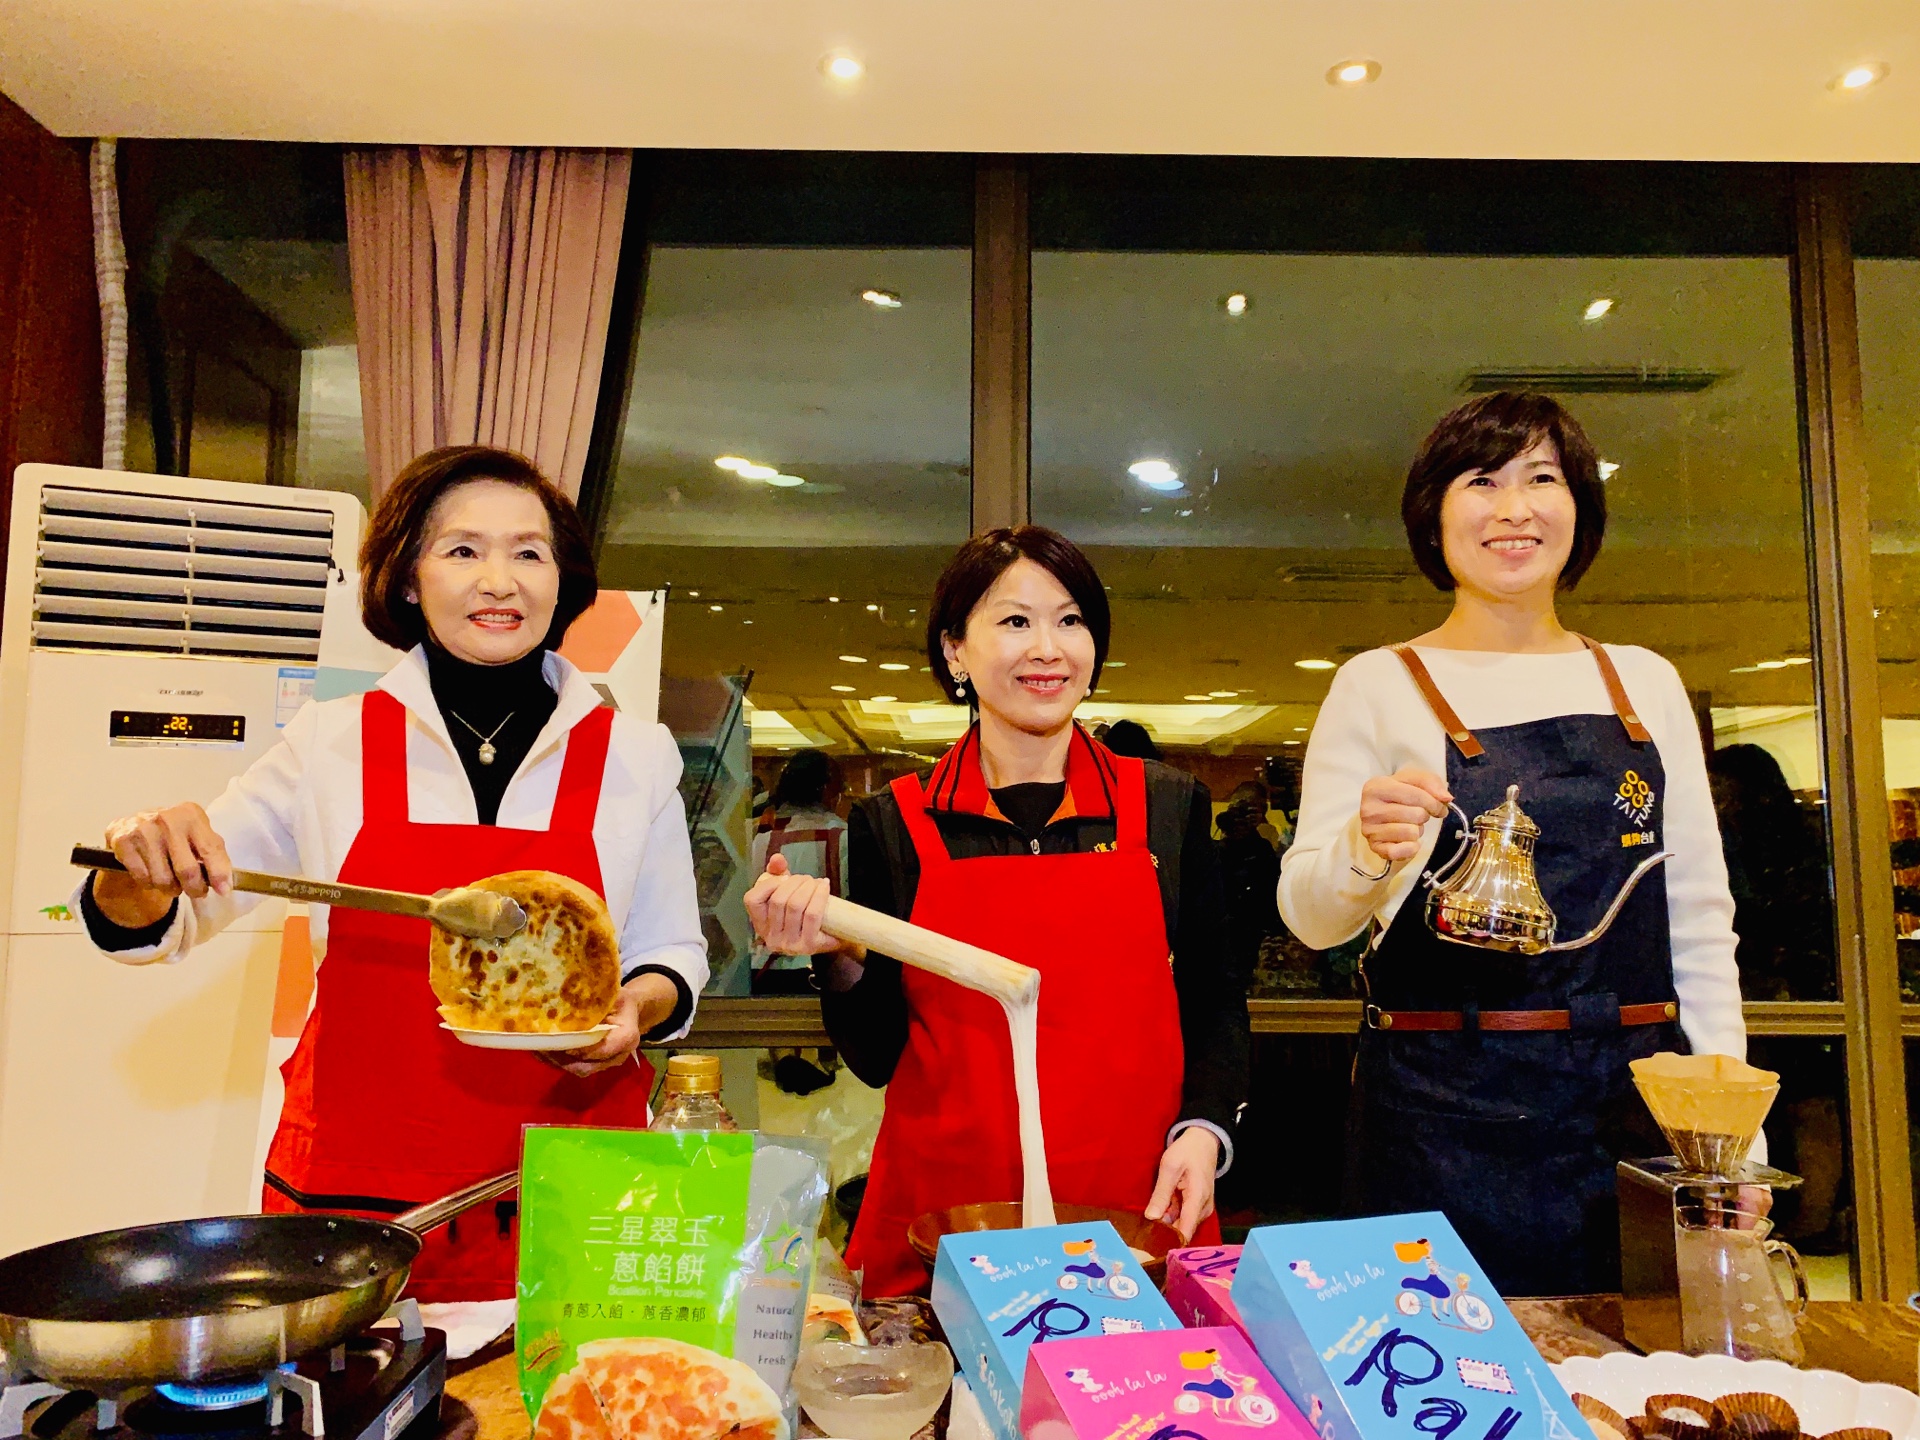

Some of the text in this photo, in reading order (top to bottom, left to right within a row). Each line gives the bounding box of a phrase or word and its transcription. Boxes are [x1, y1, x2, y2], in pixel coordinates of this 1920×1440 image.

[170, 716, 188, 730] 22
[583, 1215, 710, 1247] 三星翠玉
[609, 1250, 705, 1285] 蔥餡餅
[1017, 1259, 1034, 1274] la
[1034, 1254, 1052, 1269] la
[1347, 1269, 1366, 1289] la
[1365, 1263, 1385, 1281] la
[756, 1303, 795, 1315] Natural
[753, 1329, 793, 1342] Healthy
[758, 1355, 786, 1366] Fresh
[1124, 1377, 1145, 1391] la
[1146, 1369, 1168, 1384] la
